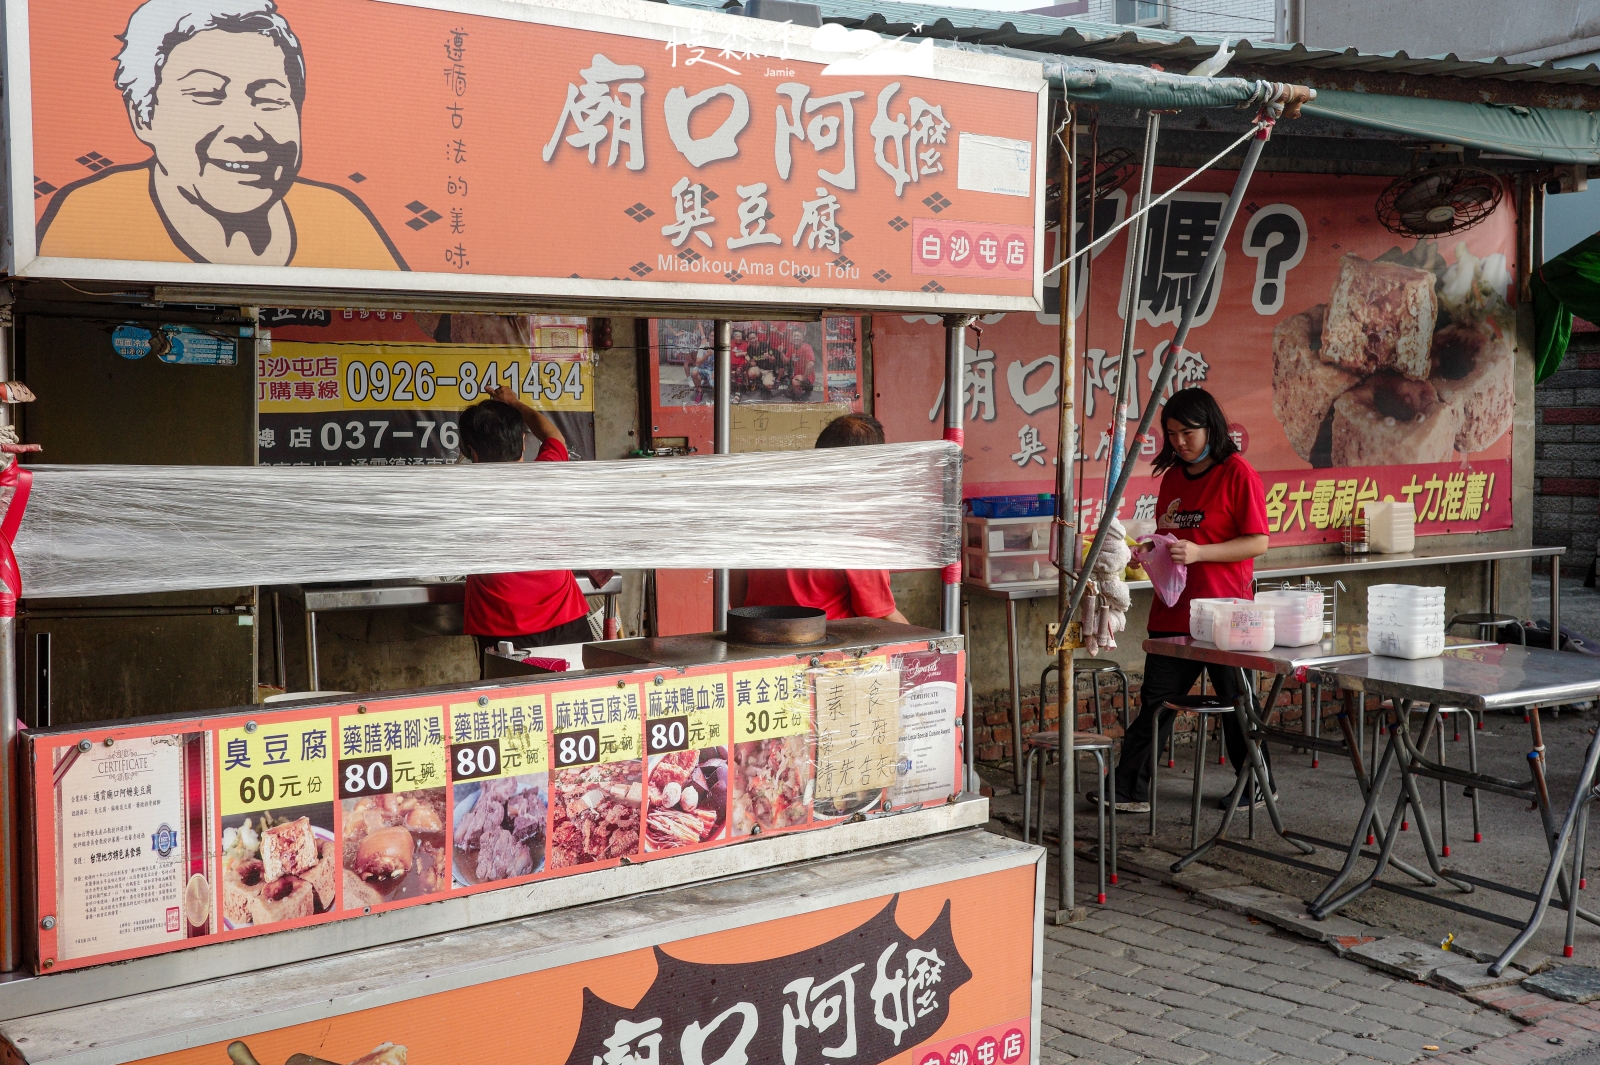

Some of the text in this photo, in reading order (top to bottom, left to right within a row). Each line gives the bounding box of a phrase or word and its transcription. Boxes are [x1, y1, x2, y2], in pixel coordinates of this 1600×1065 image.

[542, 53, 951, 197] 廟口阿嬤
[443, 27, 470, 270] 遵循古法的美味
[661, 176, 842, 254] 臭豆腐
[657, 254, 860, 279] Miaokou Ama Chou Tofu
[920, 237, 1026, 265] 白沙屯店
[346, 360, 584, 402] 0926-841434
[648, 682, 726, 718] 麻辣鴨血湯
[736, 673, 807, 707] 黃金泡菜
[454, 704, 544, 743] 藥膳排骨湯
[555, 693, 639, 730] 麻辣豆腐湯
[224, 729, 328, 771] 臭豆腐
[343, 716, 442, 757] 藥膳豬腳湯
[98, 757, 148, 774] CERTIFICATE
